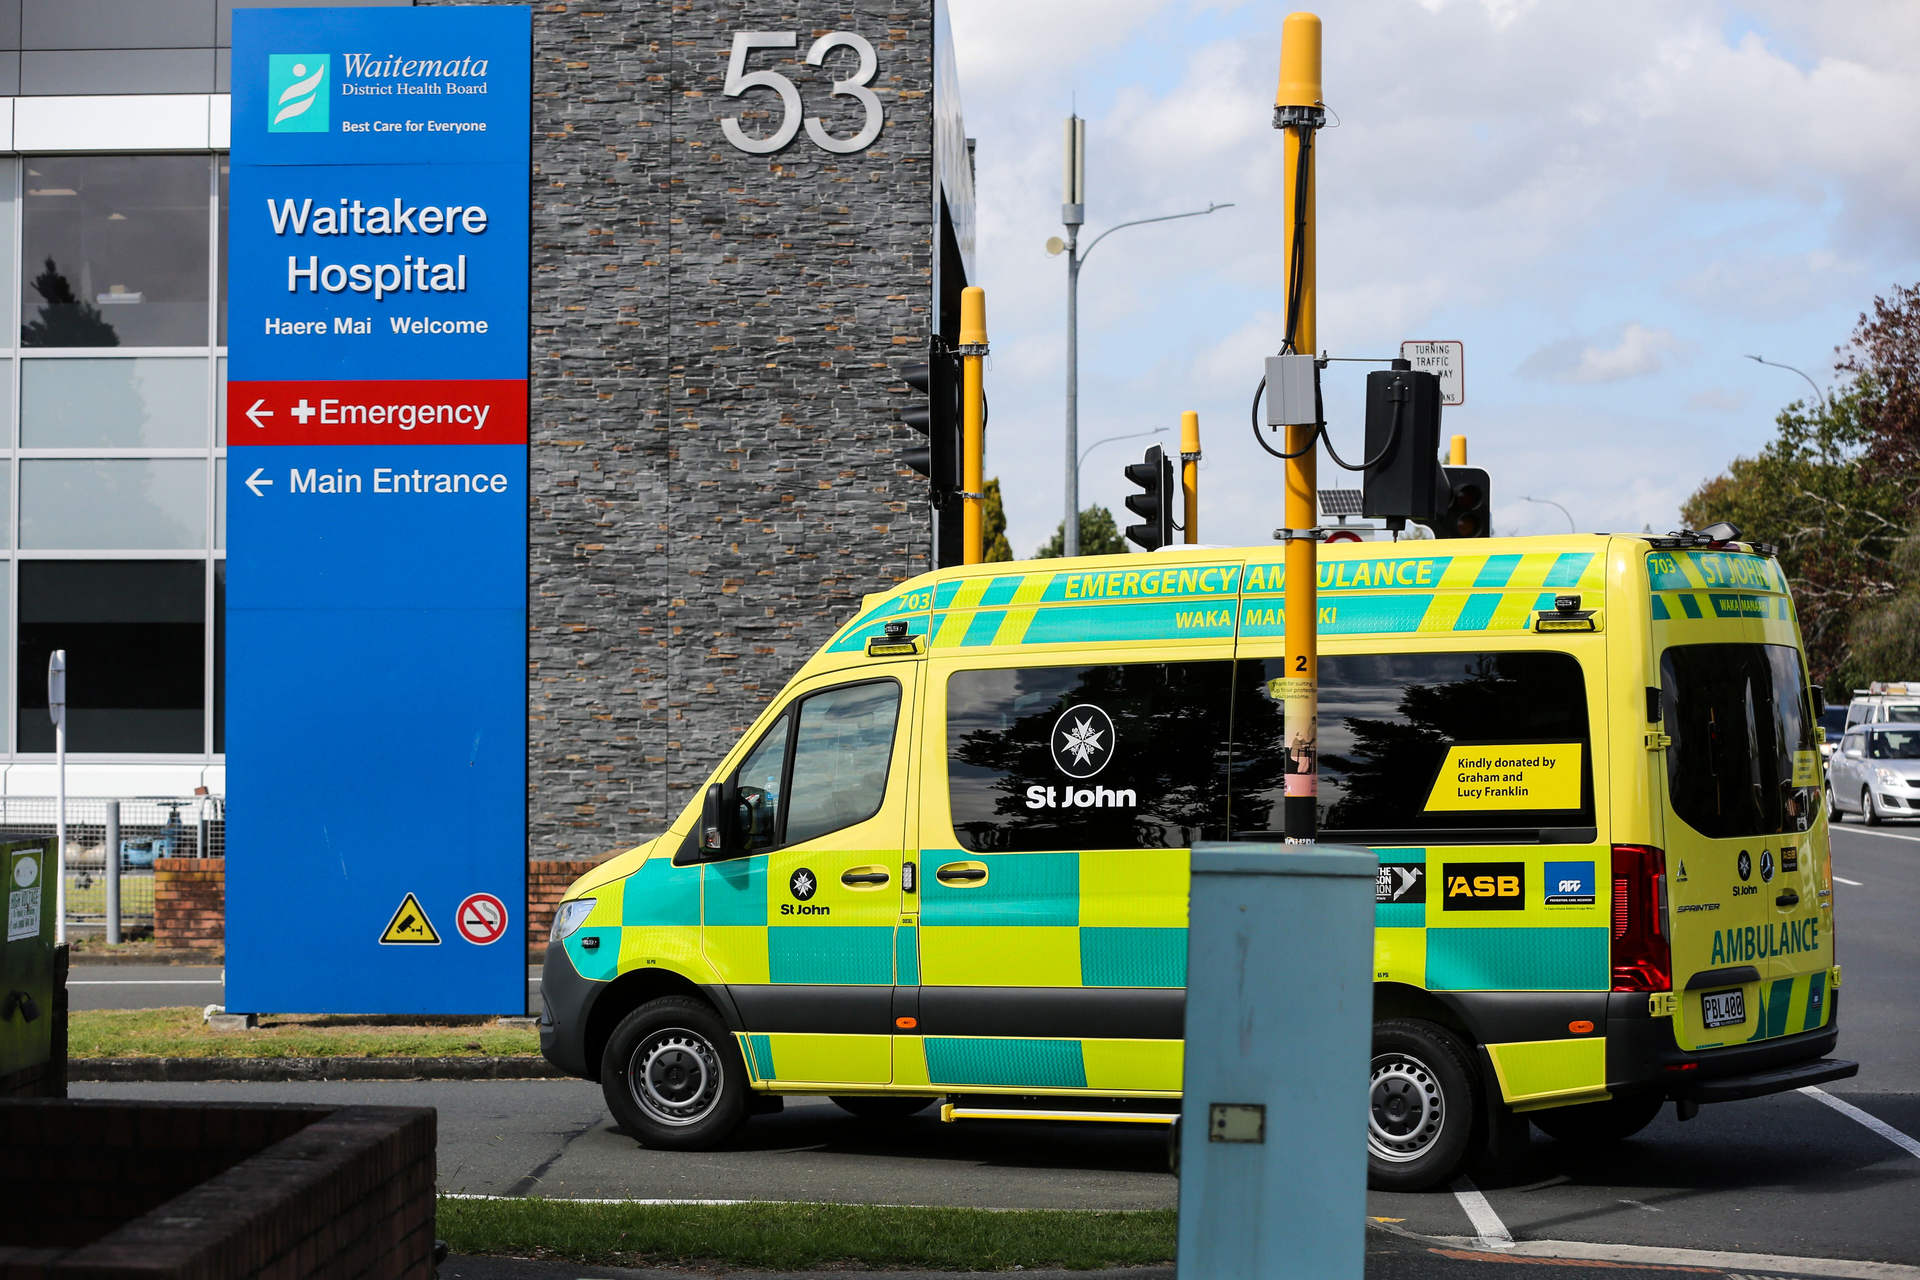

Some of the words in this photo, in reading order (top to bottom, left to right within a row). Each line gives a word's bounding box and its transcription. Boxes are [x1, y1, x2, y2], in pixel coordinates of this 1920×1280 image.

[342, 53, 489, 78] Waitemata
[342, 83, 393, 95] District
[396, 82, 442, 95] Health
[446, 82, 488, 94] Board
[720, 31, 884, 154] 53
[342, 121, 370, 132] Best
[373, 120, 402, 132] Care
[405, 120, 424, 132] for
[427, 120, 487, 134] Everyone
[267, 198, 488, 236] Waitakere
[287, 254, 467, 300] Hospital
[264, 317, 327, 335] Haere
[332, 317, 372, 335] Mai
[390, 316, 489, 334] Welcome
[1415, 345, 1449, 354] TURNING
[1416, 357, 1449, 366] TRAFFIC
[1437, 369, 1453, 378] WAY
[320, 399, 491, 430] Emergency
[290, 469, 363, 494] Main
[373, 467, 508, 494] Entrance
[1065, 567, 1237, 599] EMERGENCY
[1246, 560, 1434, 590] AMULANCE
[1650, 558, 1676, 575] 703
[1700, 556, 1725, 584] ST
[1724, 557, 1769, 587] JOHN
[898, 592, 931, 611] 703
[1175, 609, 1232, 628] WAKA
[1245, 607, 1337, 627] MANKI
[1295, 655, 1308, 672] 2
[1458, 758, 1492, 770] Kindly
[1495, 757, 1540, 767] donated
[1542, 757, 1556, 769] by
[1457, 772, 1500, 782] Graham
[1502, 772, 1523, 782] and
[1025, 786, 1057, 808] St
[1062, 785, 1136, 808] John
[1457, 787, 1482, 799] Lucy
[1485, 786, 1529, 796] Franklin
[1781, 850, 1796, 860] ASB
[1448, 875, 1520, 897] ASB
[1732, 886, 1740, 897] St
[1741, 885, 1758, 896] John
[780, 903, 794, 916] St
[796, 903, 830, 916] John
[1676, 903, 1720, 913] SPRINTER
[1711, 917, 1818, 965] AMBULANCE
[1704, 995, 1742, 1020] PBL400
